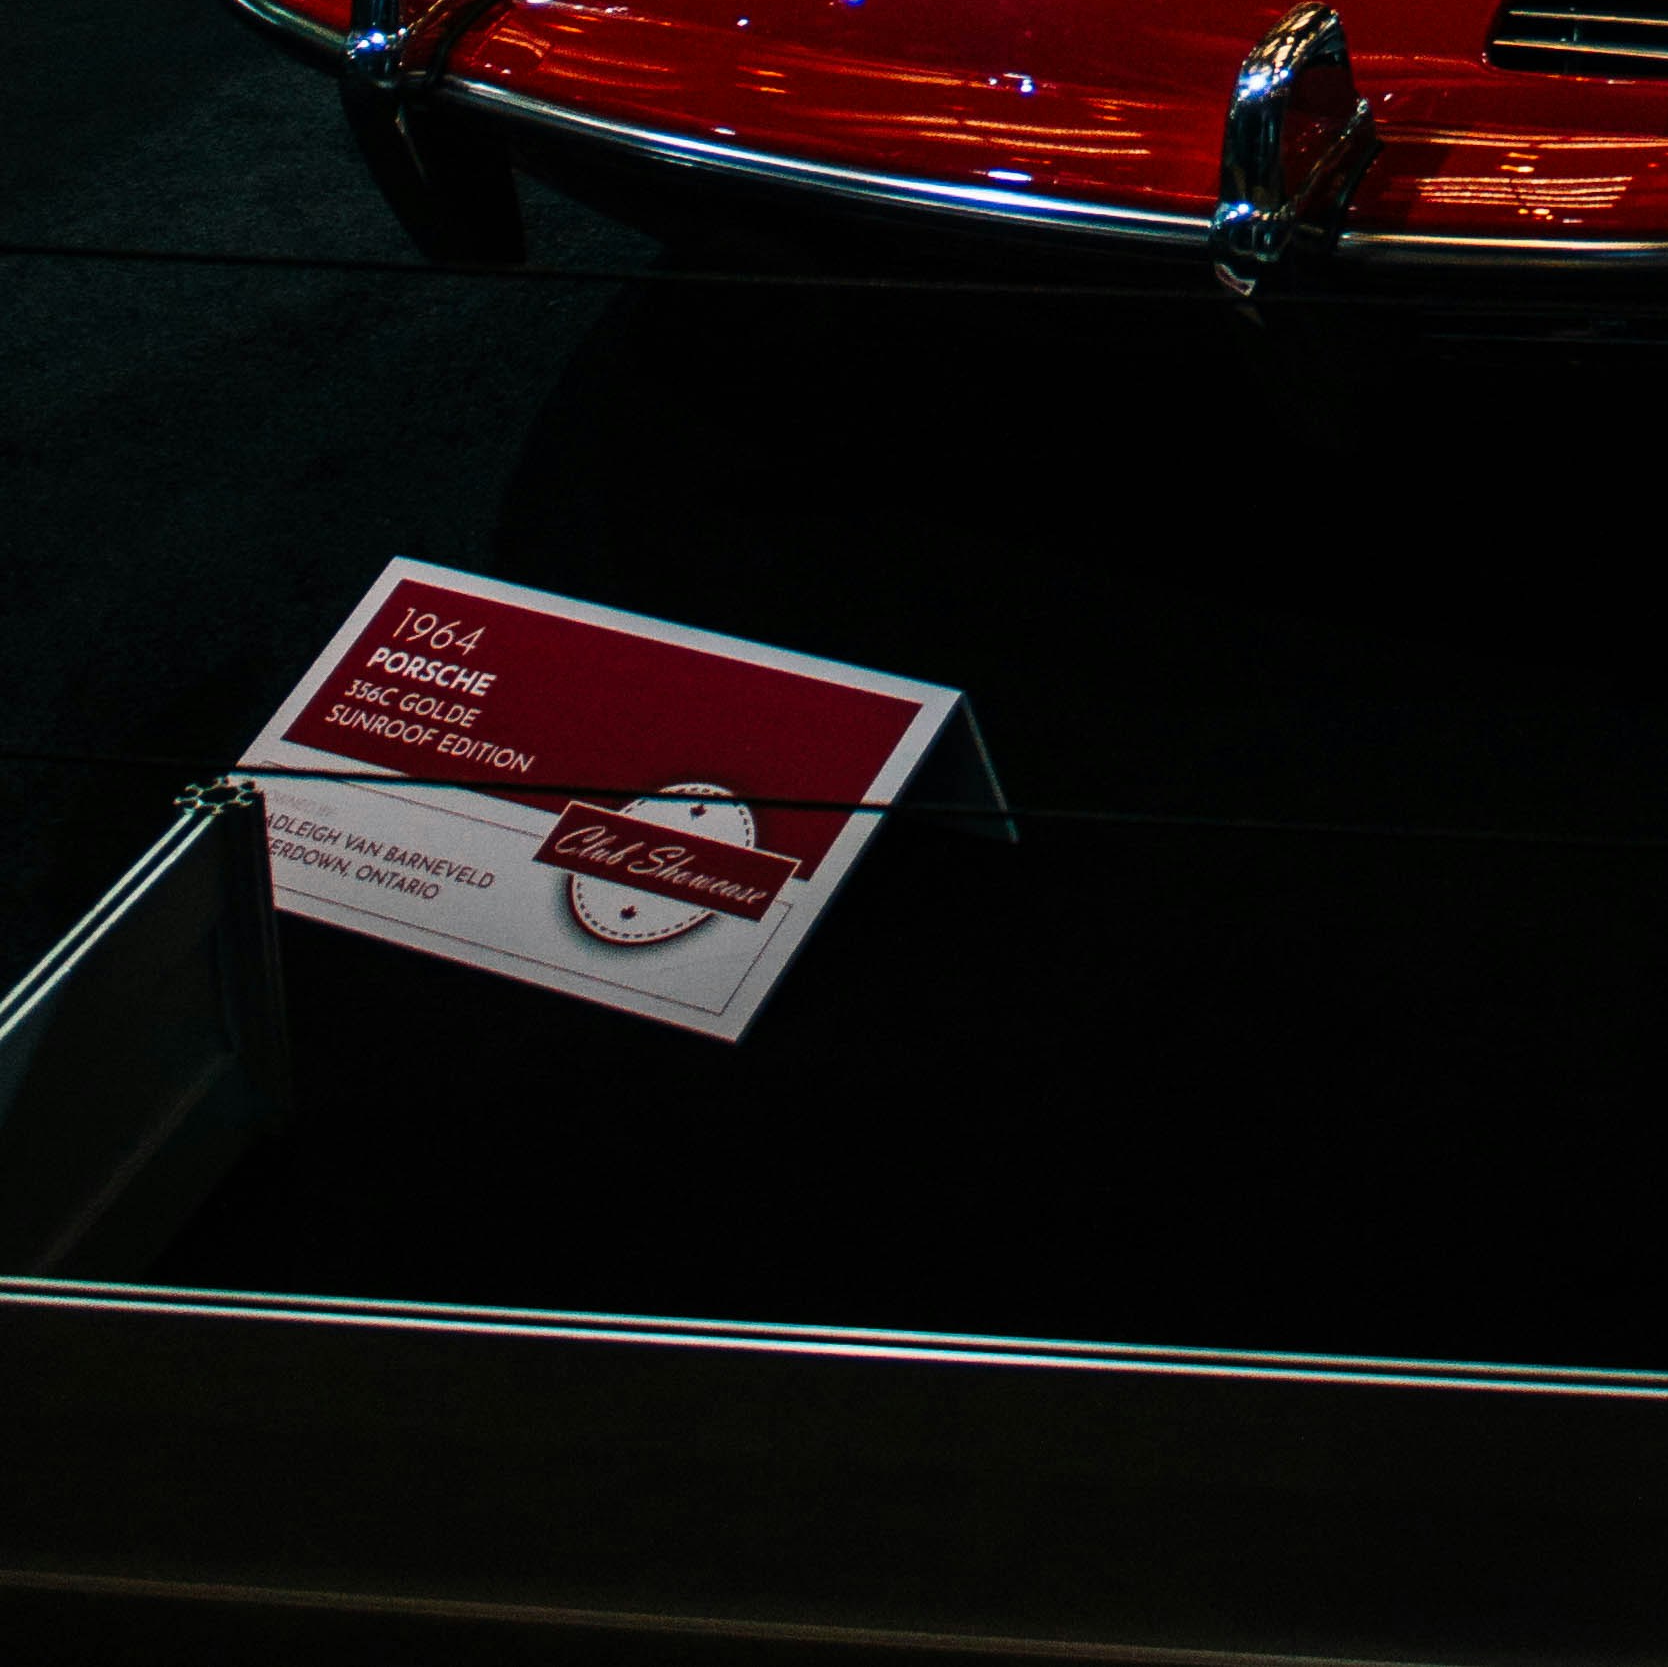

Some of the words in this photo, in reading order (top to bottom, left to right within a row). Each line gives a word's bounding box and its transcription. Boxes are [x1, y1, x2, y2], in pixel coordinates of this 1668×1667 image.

[392, 607, 487, 656] 1964
[366, 647, 498, 697] PORSCHE
[344, 679, 399, 706] 356C
[399, 693, 483, 729] GOLDE
[325, 703, 440, 746] SUNROOF
[436, 733, 536, 773] EDITION
[344, 833, 384, 858] VAN
[383, 846, 496, 889] BARNEVELD
[356, 864, 440, 900] ONTARIO
[554, 825, 646, 865] Club
[626, 846, 768, 905] Showcase
